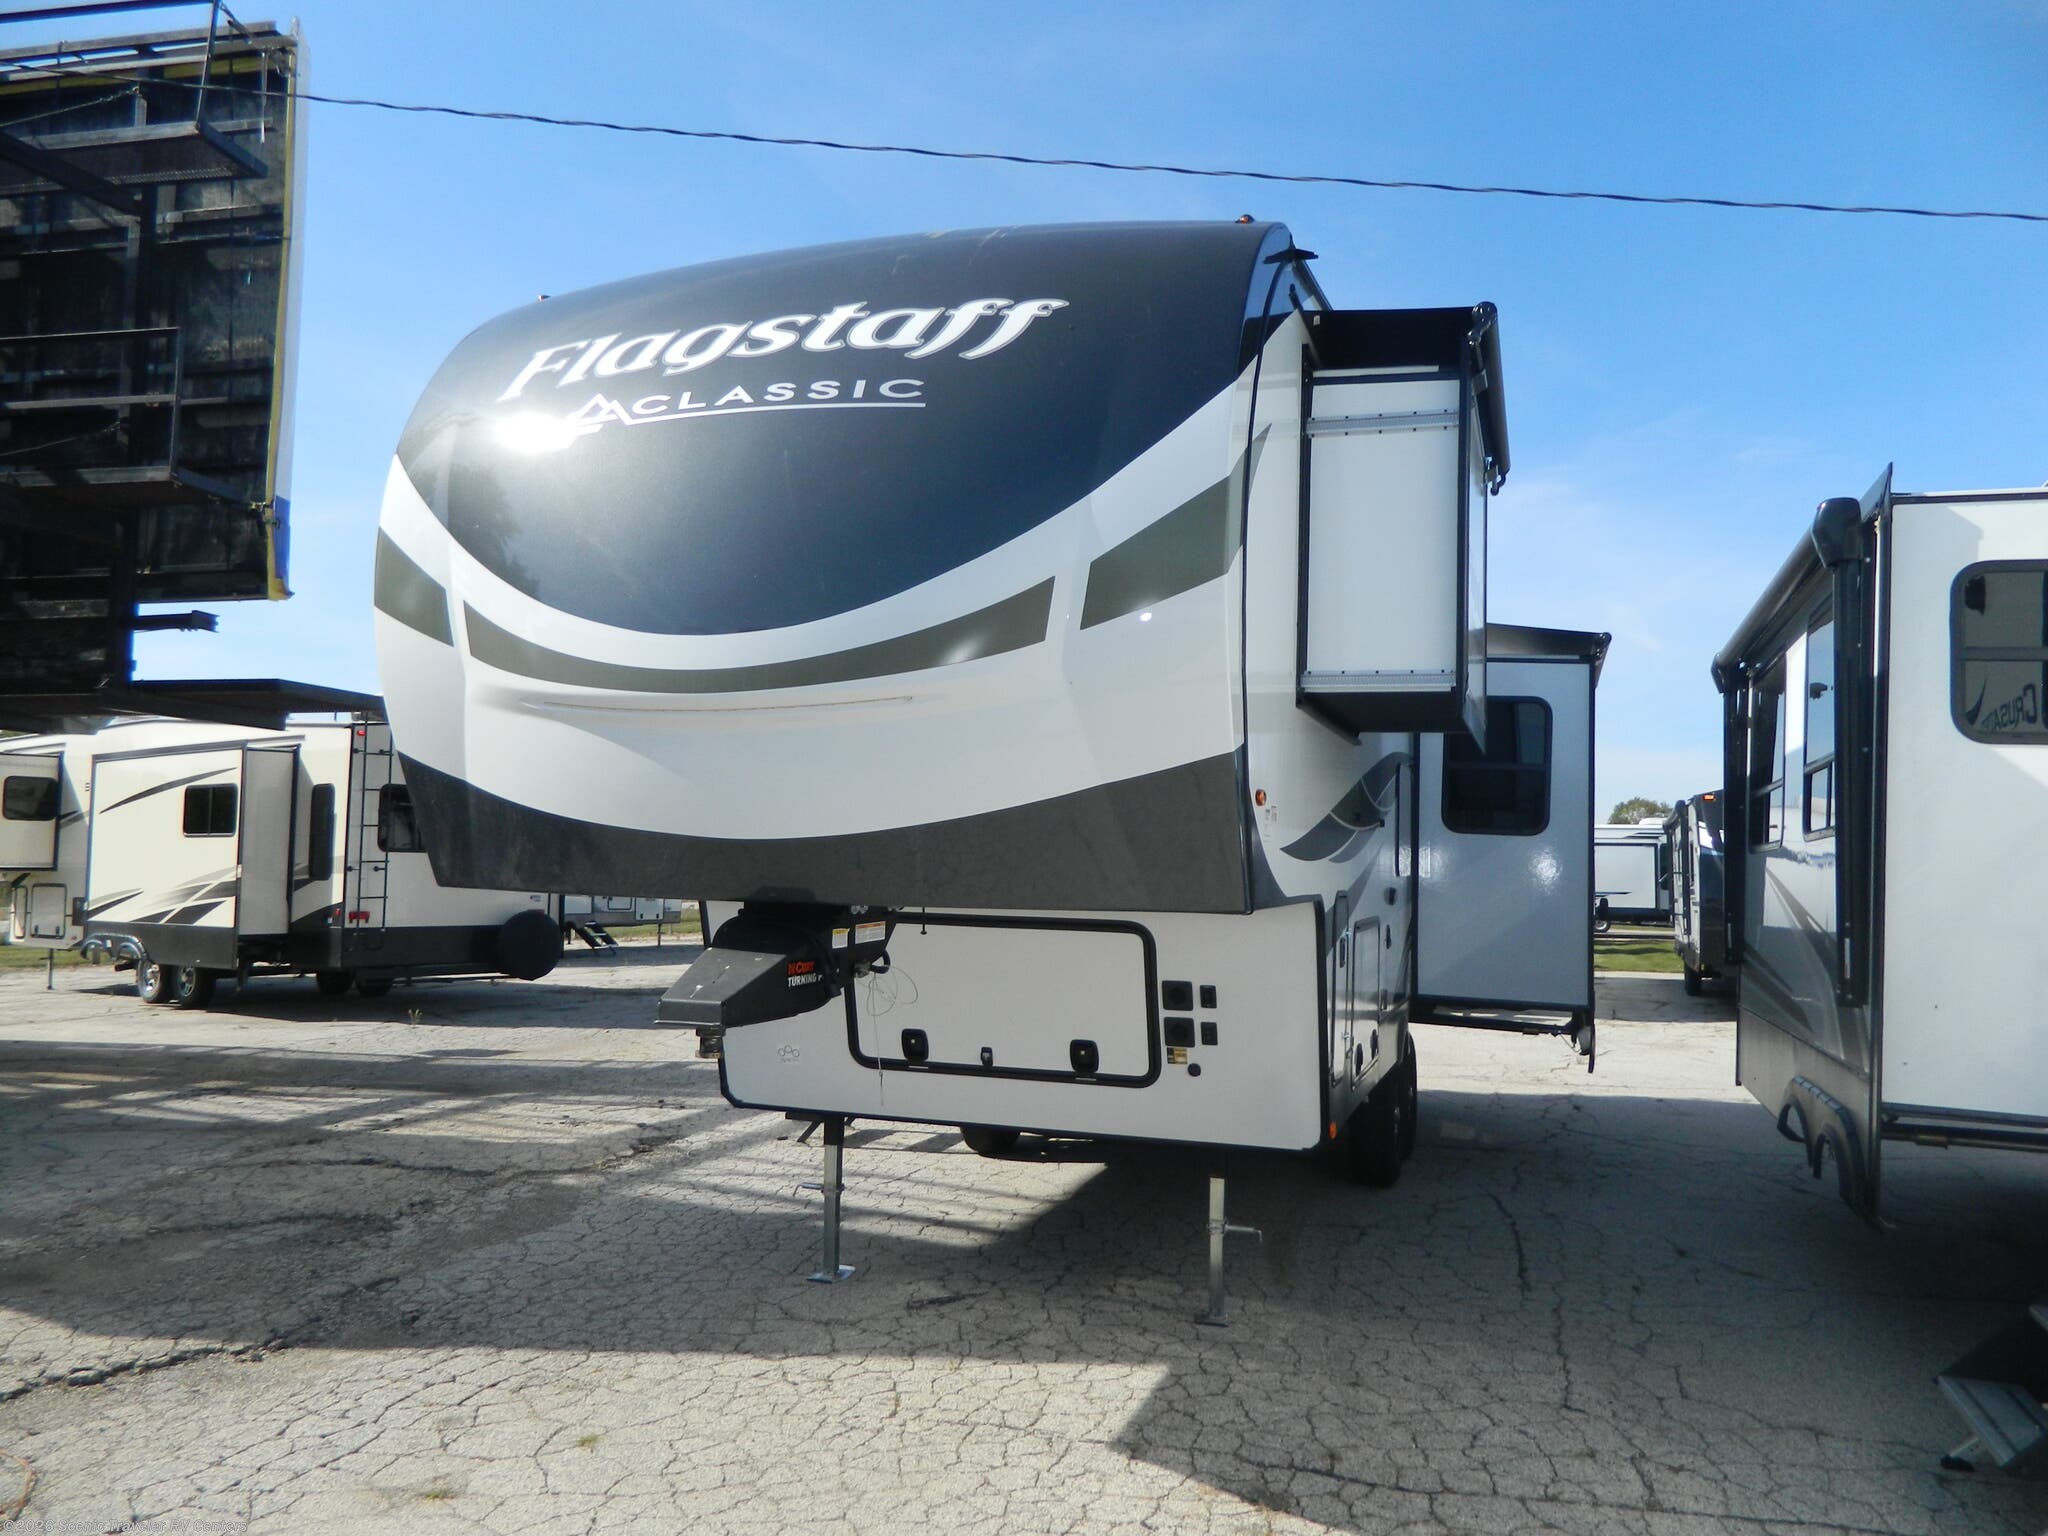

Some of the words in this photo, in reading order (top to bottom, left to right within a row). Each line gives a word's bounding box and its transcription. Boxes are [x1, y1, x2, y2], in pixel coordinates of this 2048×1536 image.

[497, 298, 1070, 403] Flagstaff
[631, 378, 926, 415] CLASSIC
[787, 972, 817, 988] TURNING
